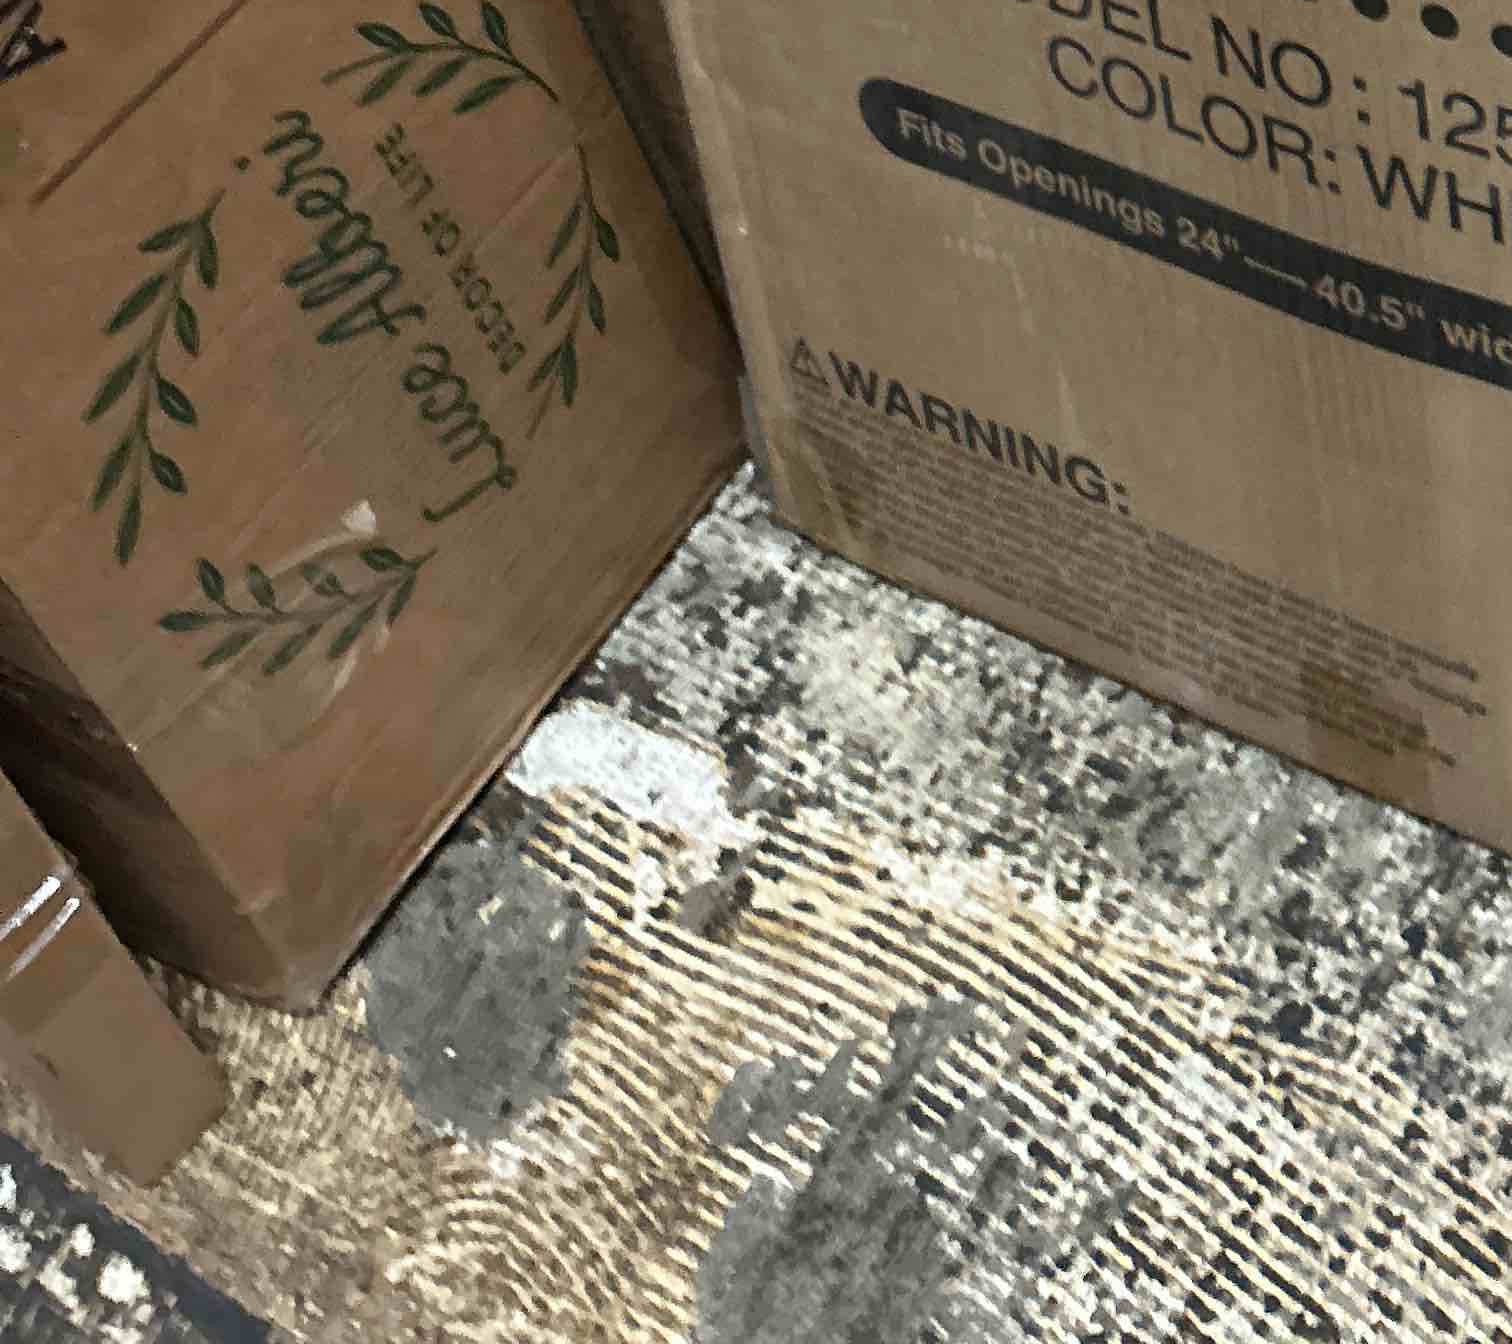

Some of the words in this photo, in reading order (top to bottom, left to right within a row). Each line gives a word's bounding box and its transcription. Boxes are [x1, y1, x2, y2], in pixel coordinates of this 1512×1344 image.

[898, 107, 967, 160] Fits
[977, 140, 1164, 238] Openings
[828, 349, 1132, 515] WARNING:
